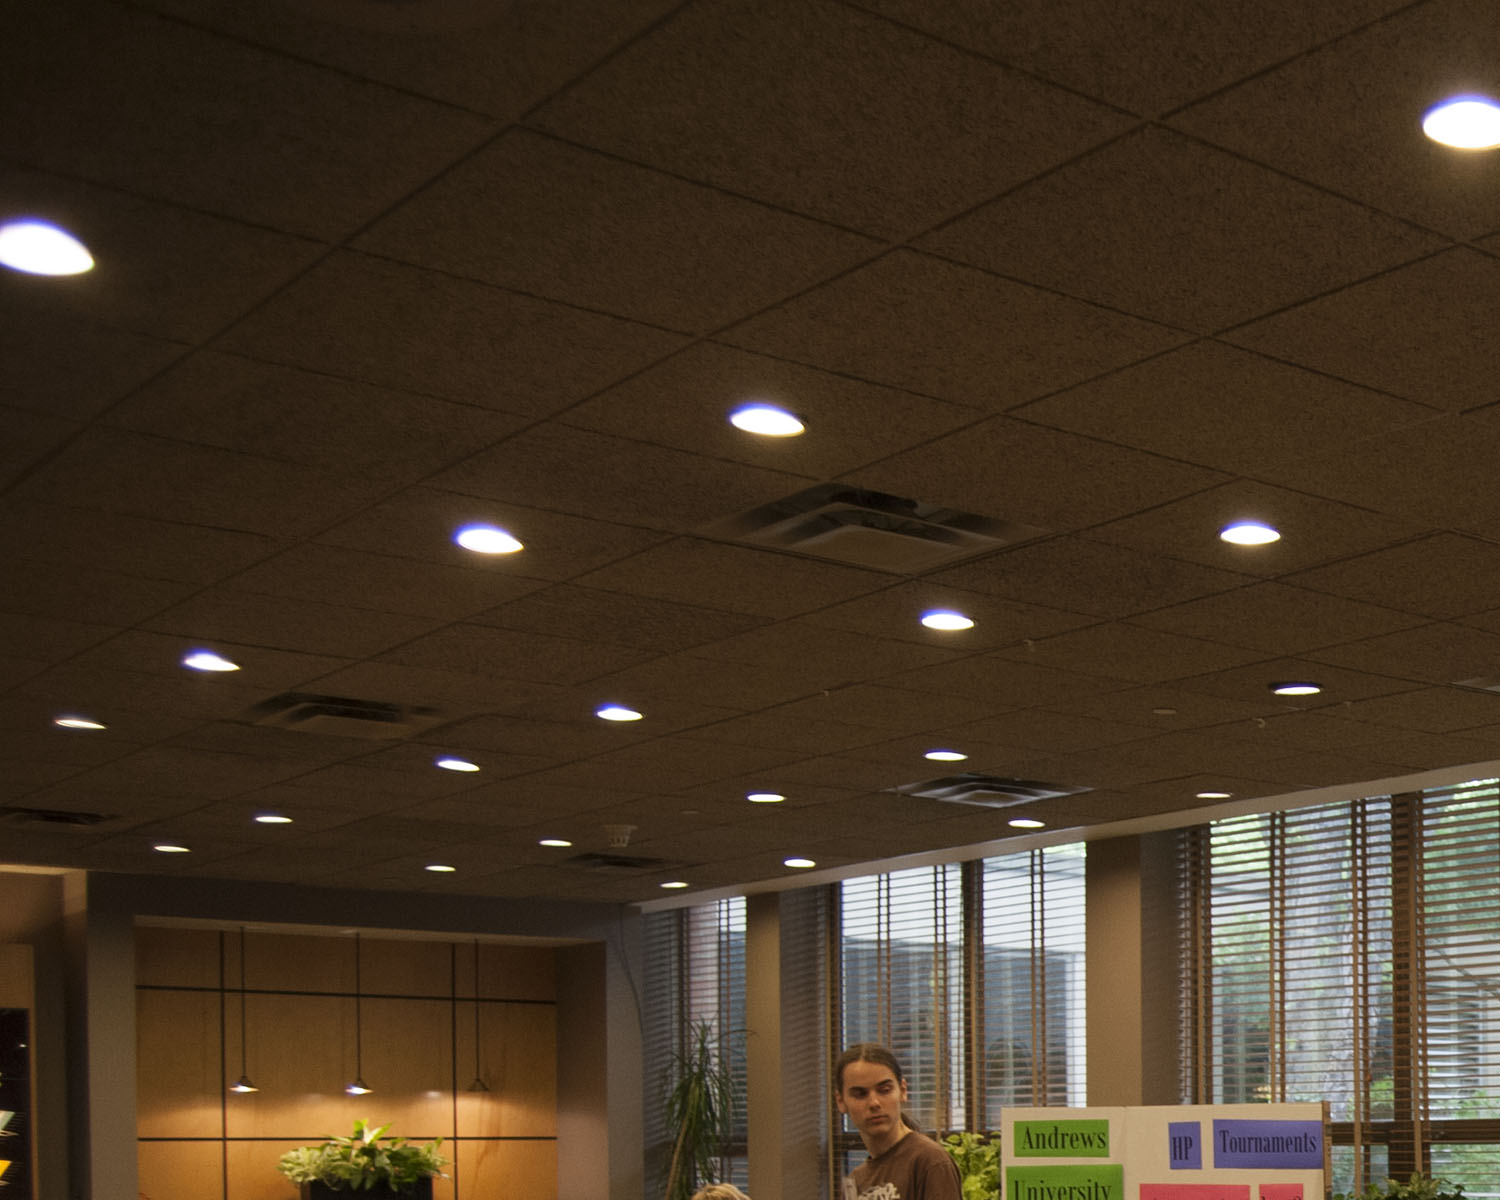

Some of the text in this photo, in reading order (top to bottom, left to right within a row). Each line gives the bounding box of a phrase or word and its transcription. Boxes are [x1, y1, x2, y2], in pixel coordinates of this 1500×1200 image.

[1021, 1126, 1106, 1150] Andrews
[1172, 1130, 1317, 1160] HP Tournaments
